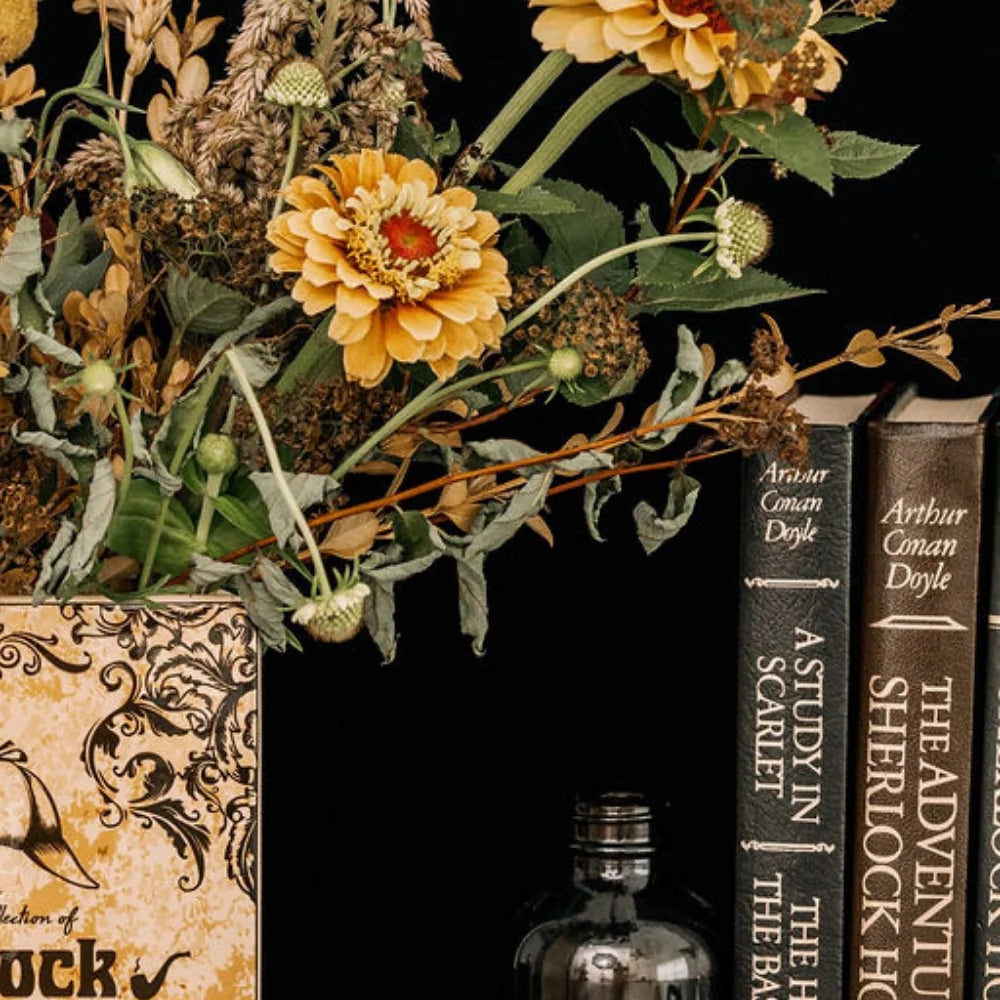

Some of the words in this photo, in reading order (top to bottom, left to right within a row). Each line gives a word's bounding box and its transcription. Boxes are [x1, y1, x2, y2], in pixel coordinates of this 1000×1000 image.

[761, 490, 823, 512] Conan
[880, 497, 968, 525] Arthur
[765, 517, 818, 550] Doyle
[883, 529, 958, 557] Conan
[885, 562, 952, 598] Doyle
[794, 626, 825, 651] A
[755, 656, 786, 799] SCARLET
[792, 658, 825, 776] STUDY
[919, 677, 953, 753] THE
[791, 783, 822, 825] IN
[861, 675, 909, 936] SHERLOCK
[58, 906, 80, 936] of
[753, 872, 782, 944] THE
[789, 896, 820, 968] THE
